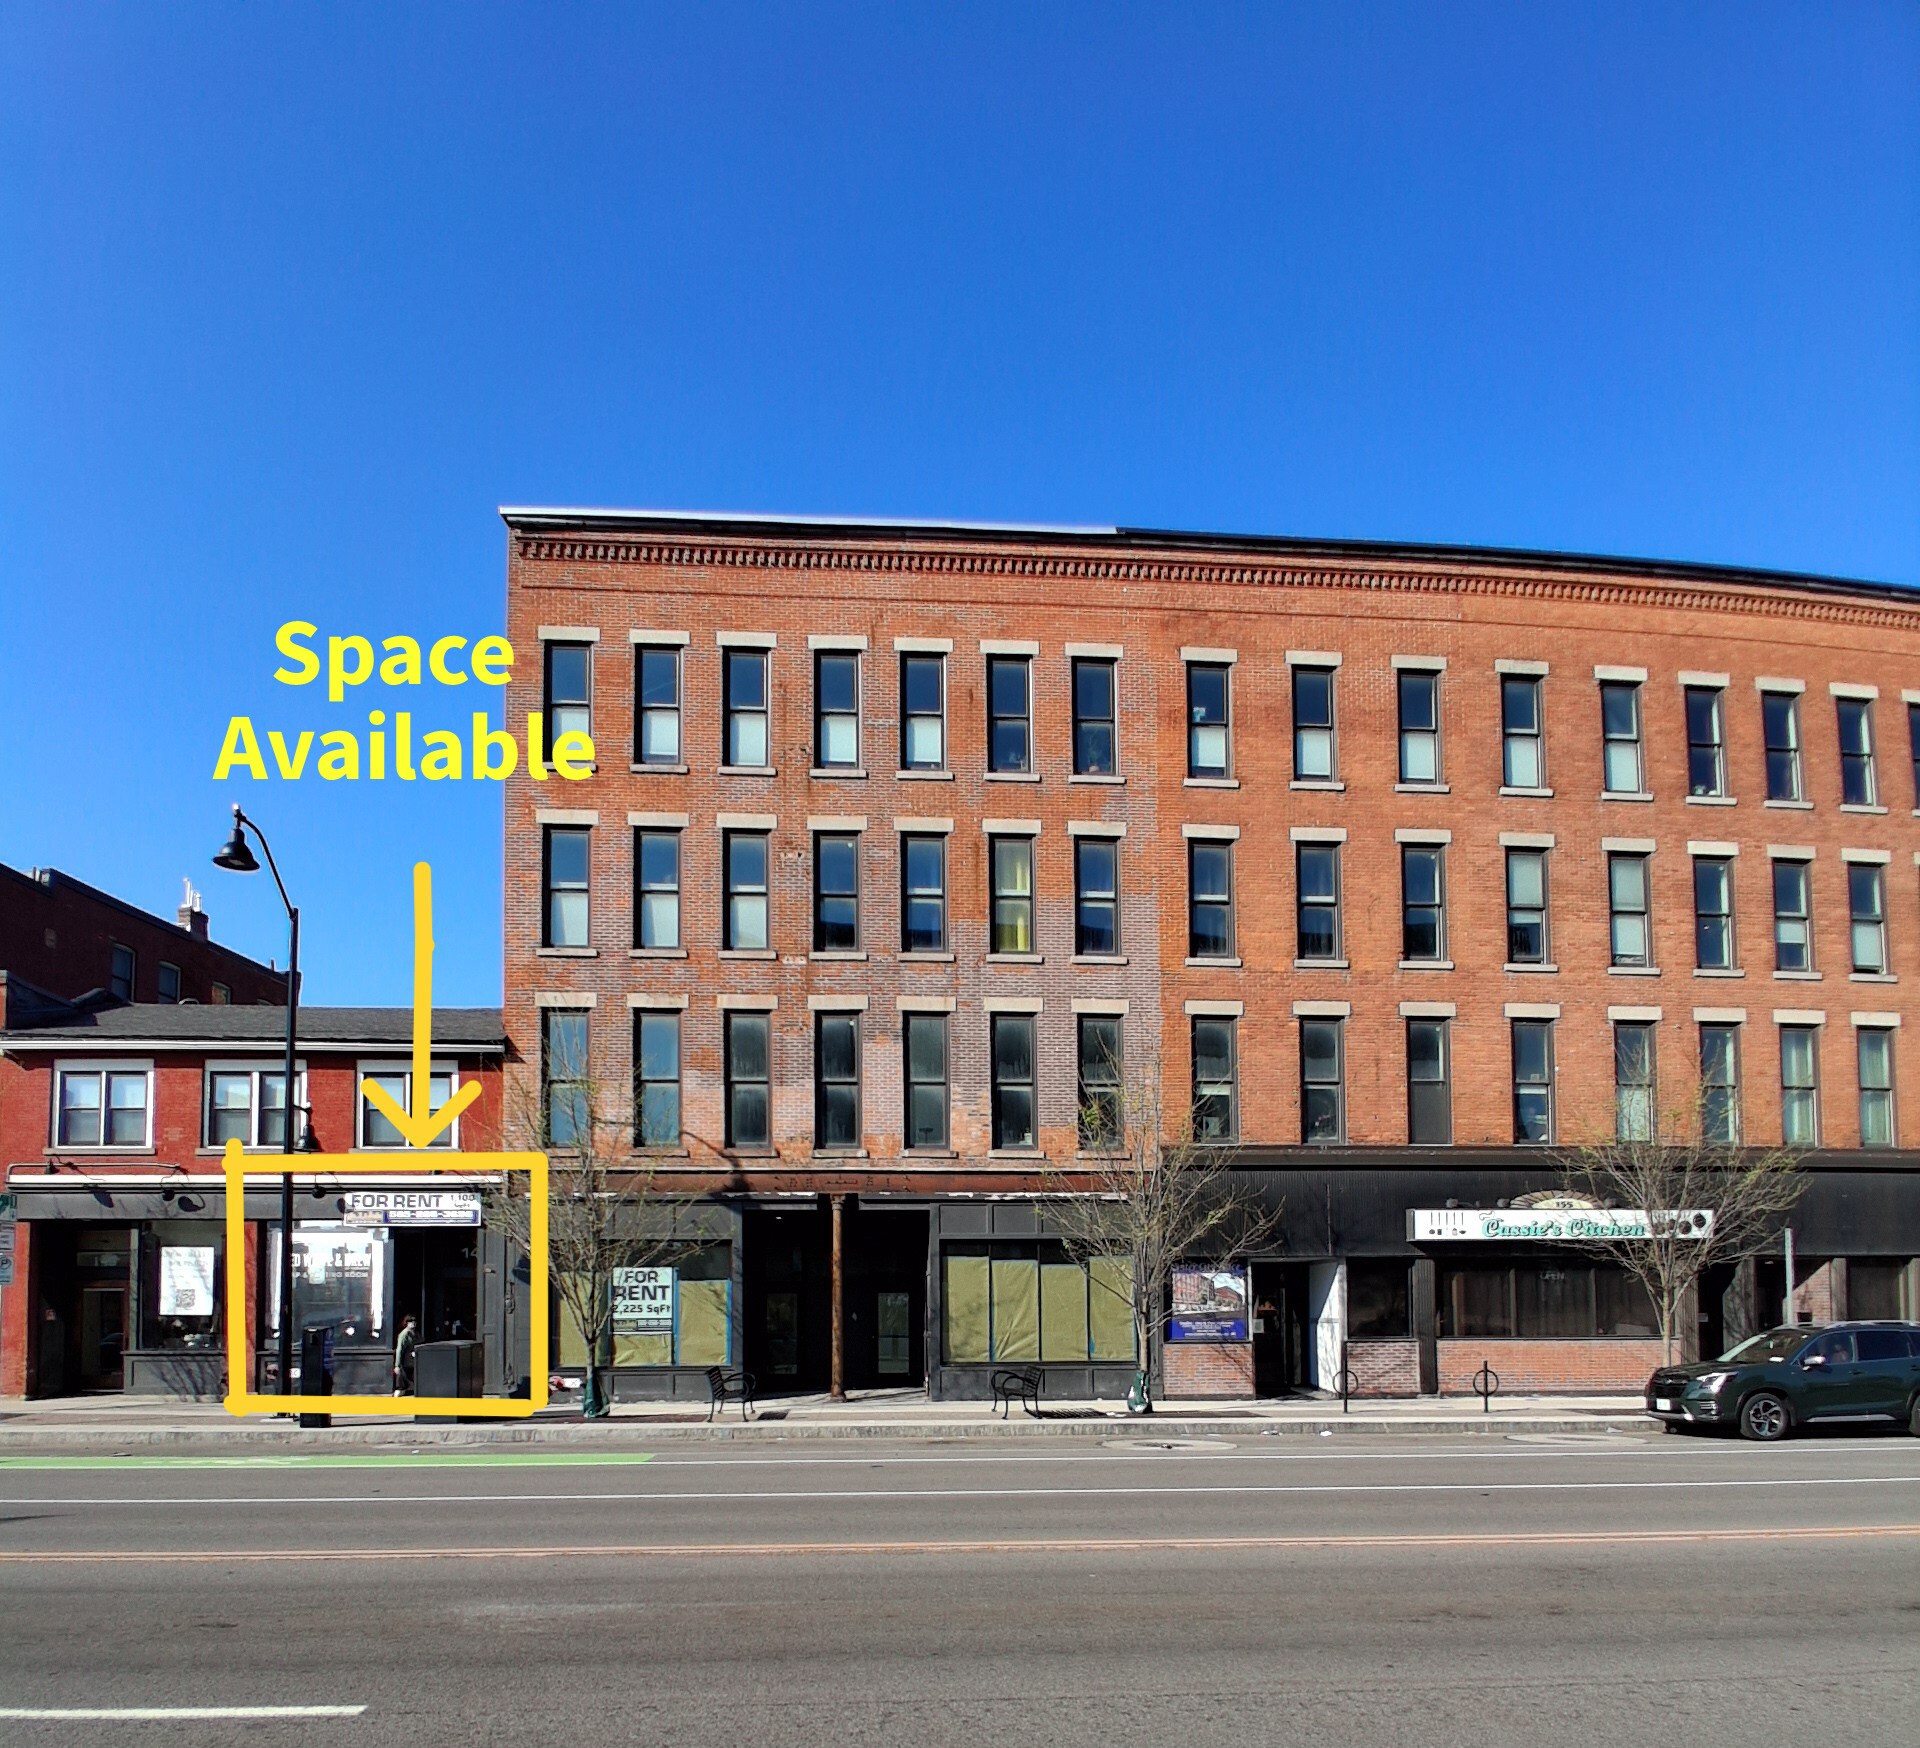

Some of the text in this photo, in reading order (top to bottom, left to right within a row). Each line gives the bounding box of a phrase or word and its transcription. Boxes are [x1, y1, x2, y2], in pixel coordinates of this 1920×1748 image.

[351, 1194, 389, 1208] FOR
[393, 1194, 443, 1208] RENT
[1555, 1200, 1574, 1209] 155
[624, 1270, 659, 1284] FOR
[612, 1285, 671, 1301] RENT
[611, 1304, 671, 1315] 2,225 SqFt
